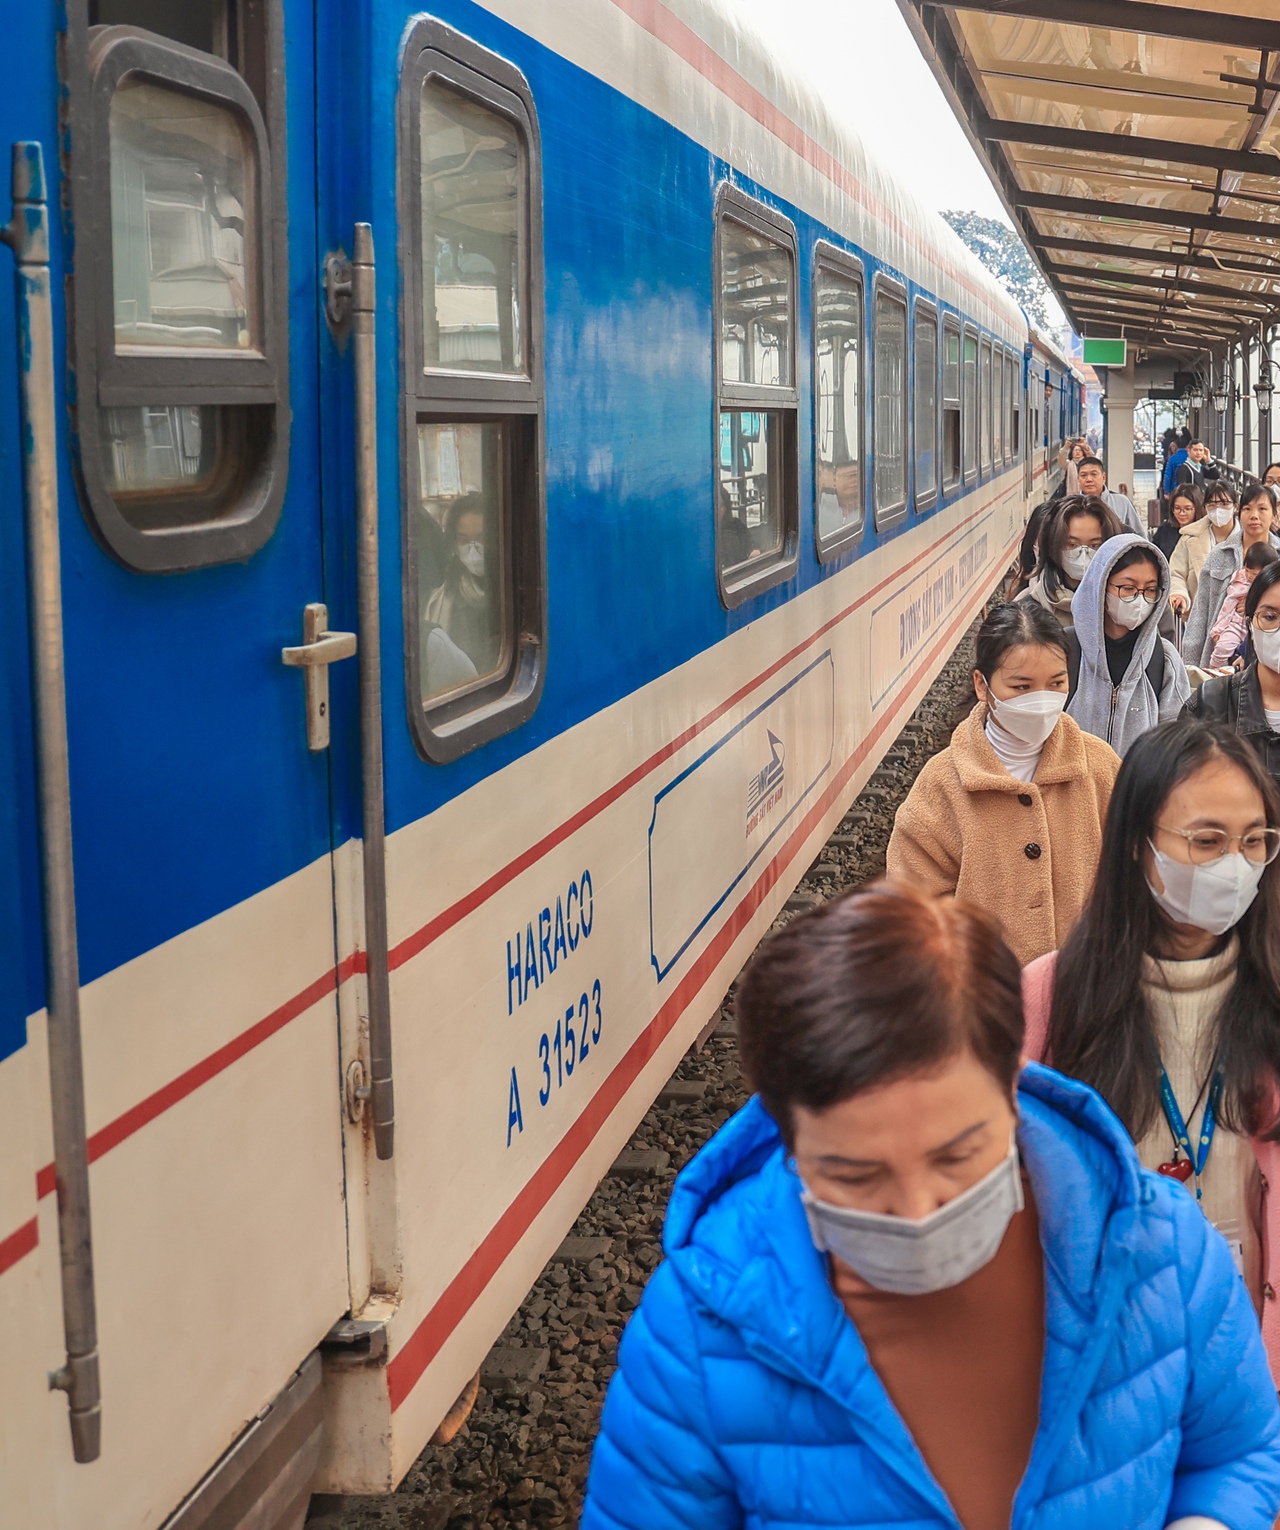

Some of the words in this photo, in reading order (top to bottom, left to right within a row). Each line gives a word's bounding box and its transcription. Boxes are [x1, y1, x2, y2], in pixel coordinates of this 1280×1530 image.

[506, 869, 594, 1017] HARACO
[506, 1066, 524, 1150] A
[538, 978, 602, 1107] 31523
